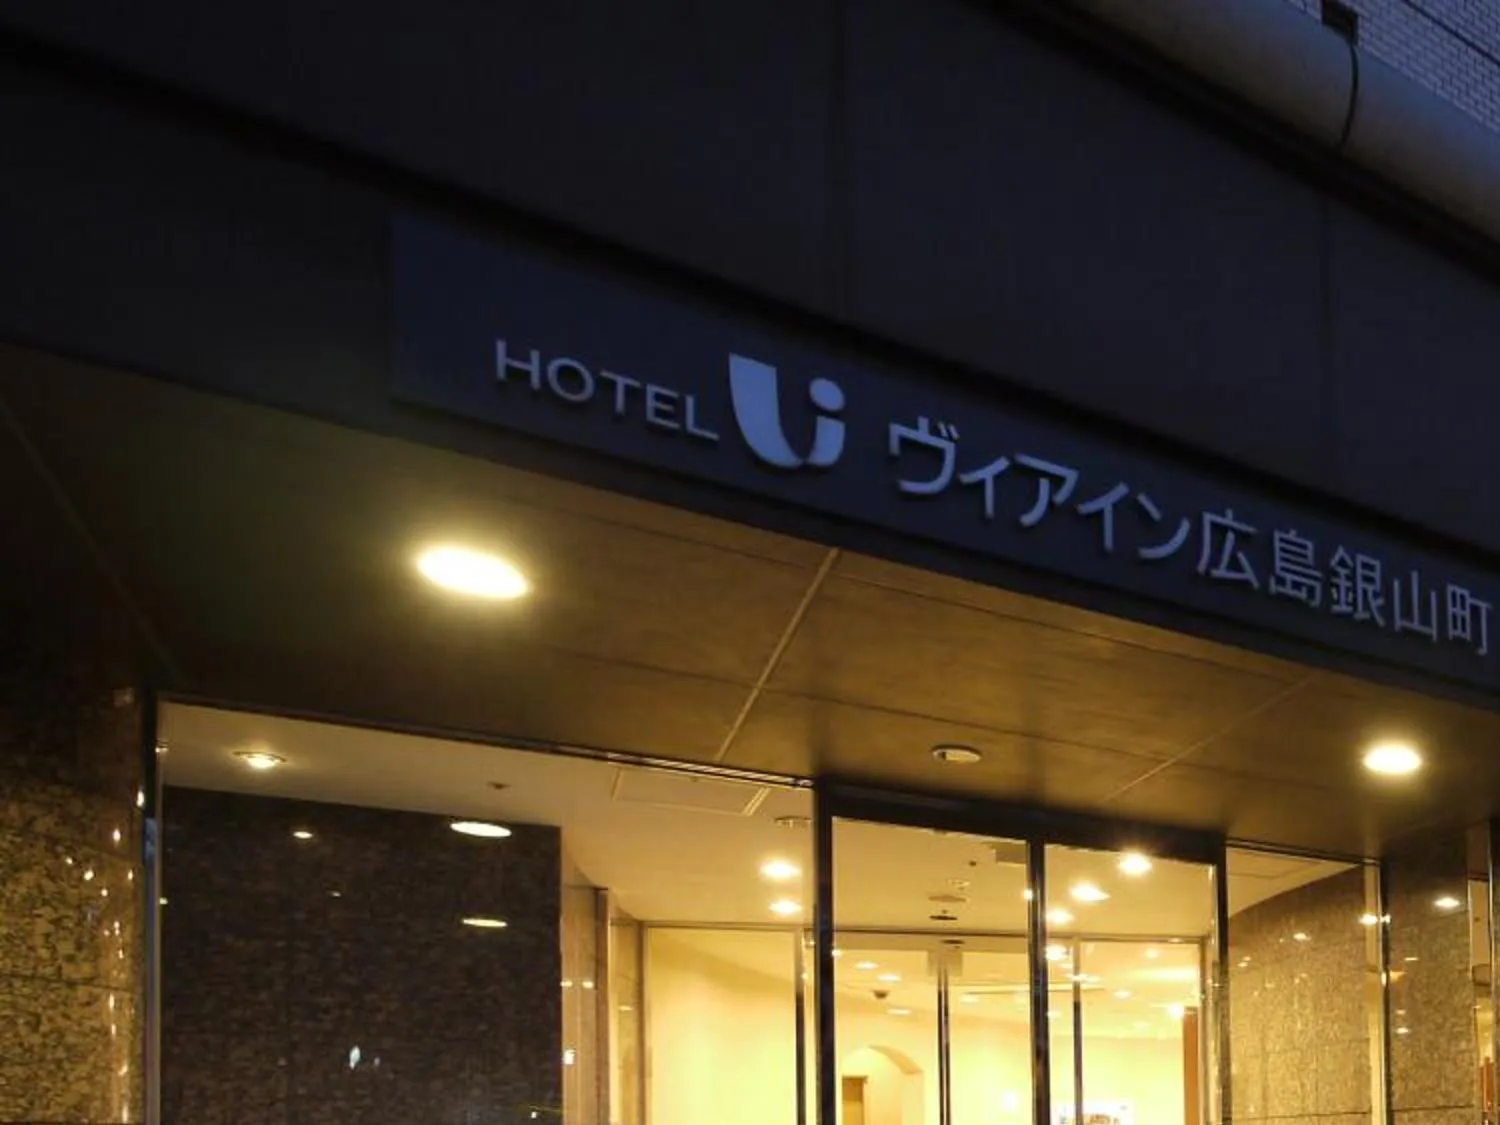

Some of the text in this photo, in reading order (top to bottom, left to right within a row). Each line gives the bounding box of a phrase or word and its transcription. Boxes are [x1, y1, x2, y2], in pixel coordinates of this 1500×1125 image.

[494, 339, 720, 441] HOTEL
[889, 416, 1492, 656] ヴィアイン広島銀山町
